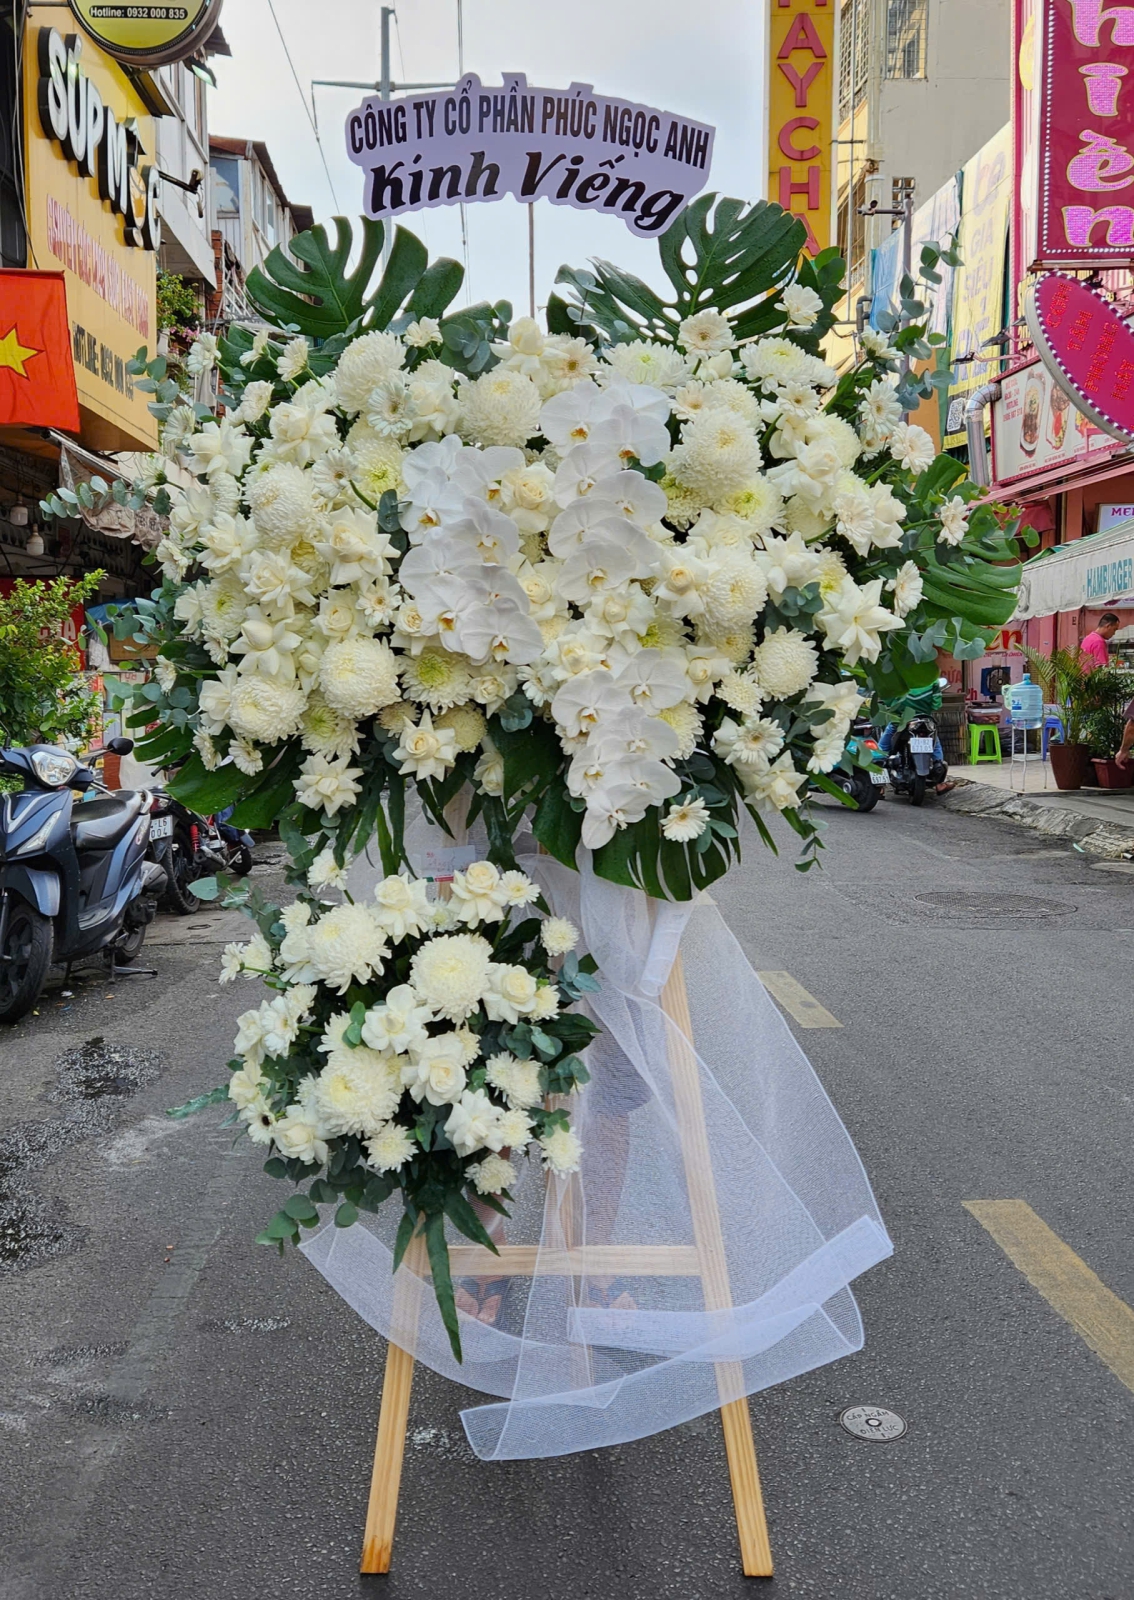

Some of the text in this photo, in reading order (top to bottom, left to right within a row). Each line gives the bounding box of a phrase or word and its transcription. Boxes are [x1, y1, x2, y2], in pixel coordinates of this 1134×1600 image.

[90, 7, 186, 19] Hotline: 0932 000 835
[350, 79, 710, 170] CÔNG TY CỔ PHẦN PHÚC NGỌC ANH
[777, 0, 828, 257] AYCHA
[370, 150, 685, 232] Kính Viếng
[1086, 557, 1133, 599] HAMBURGER
